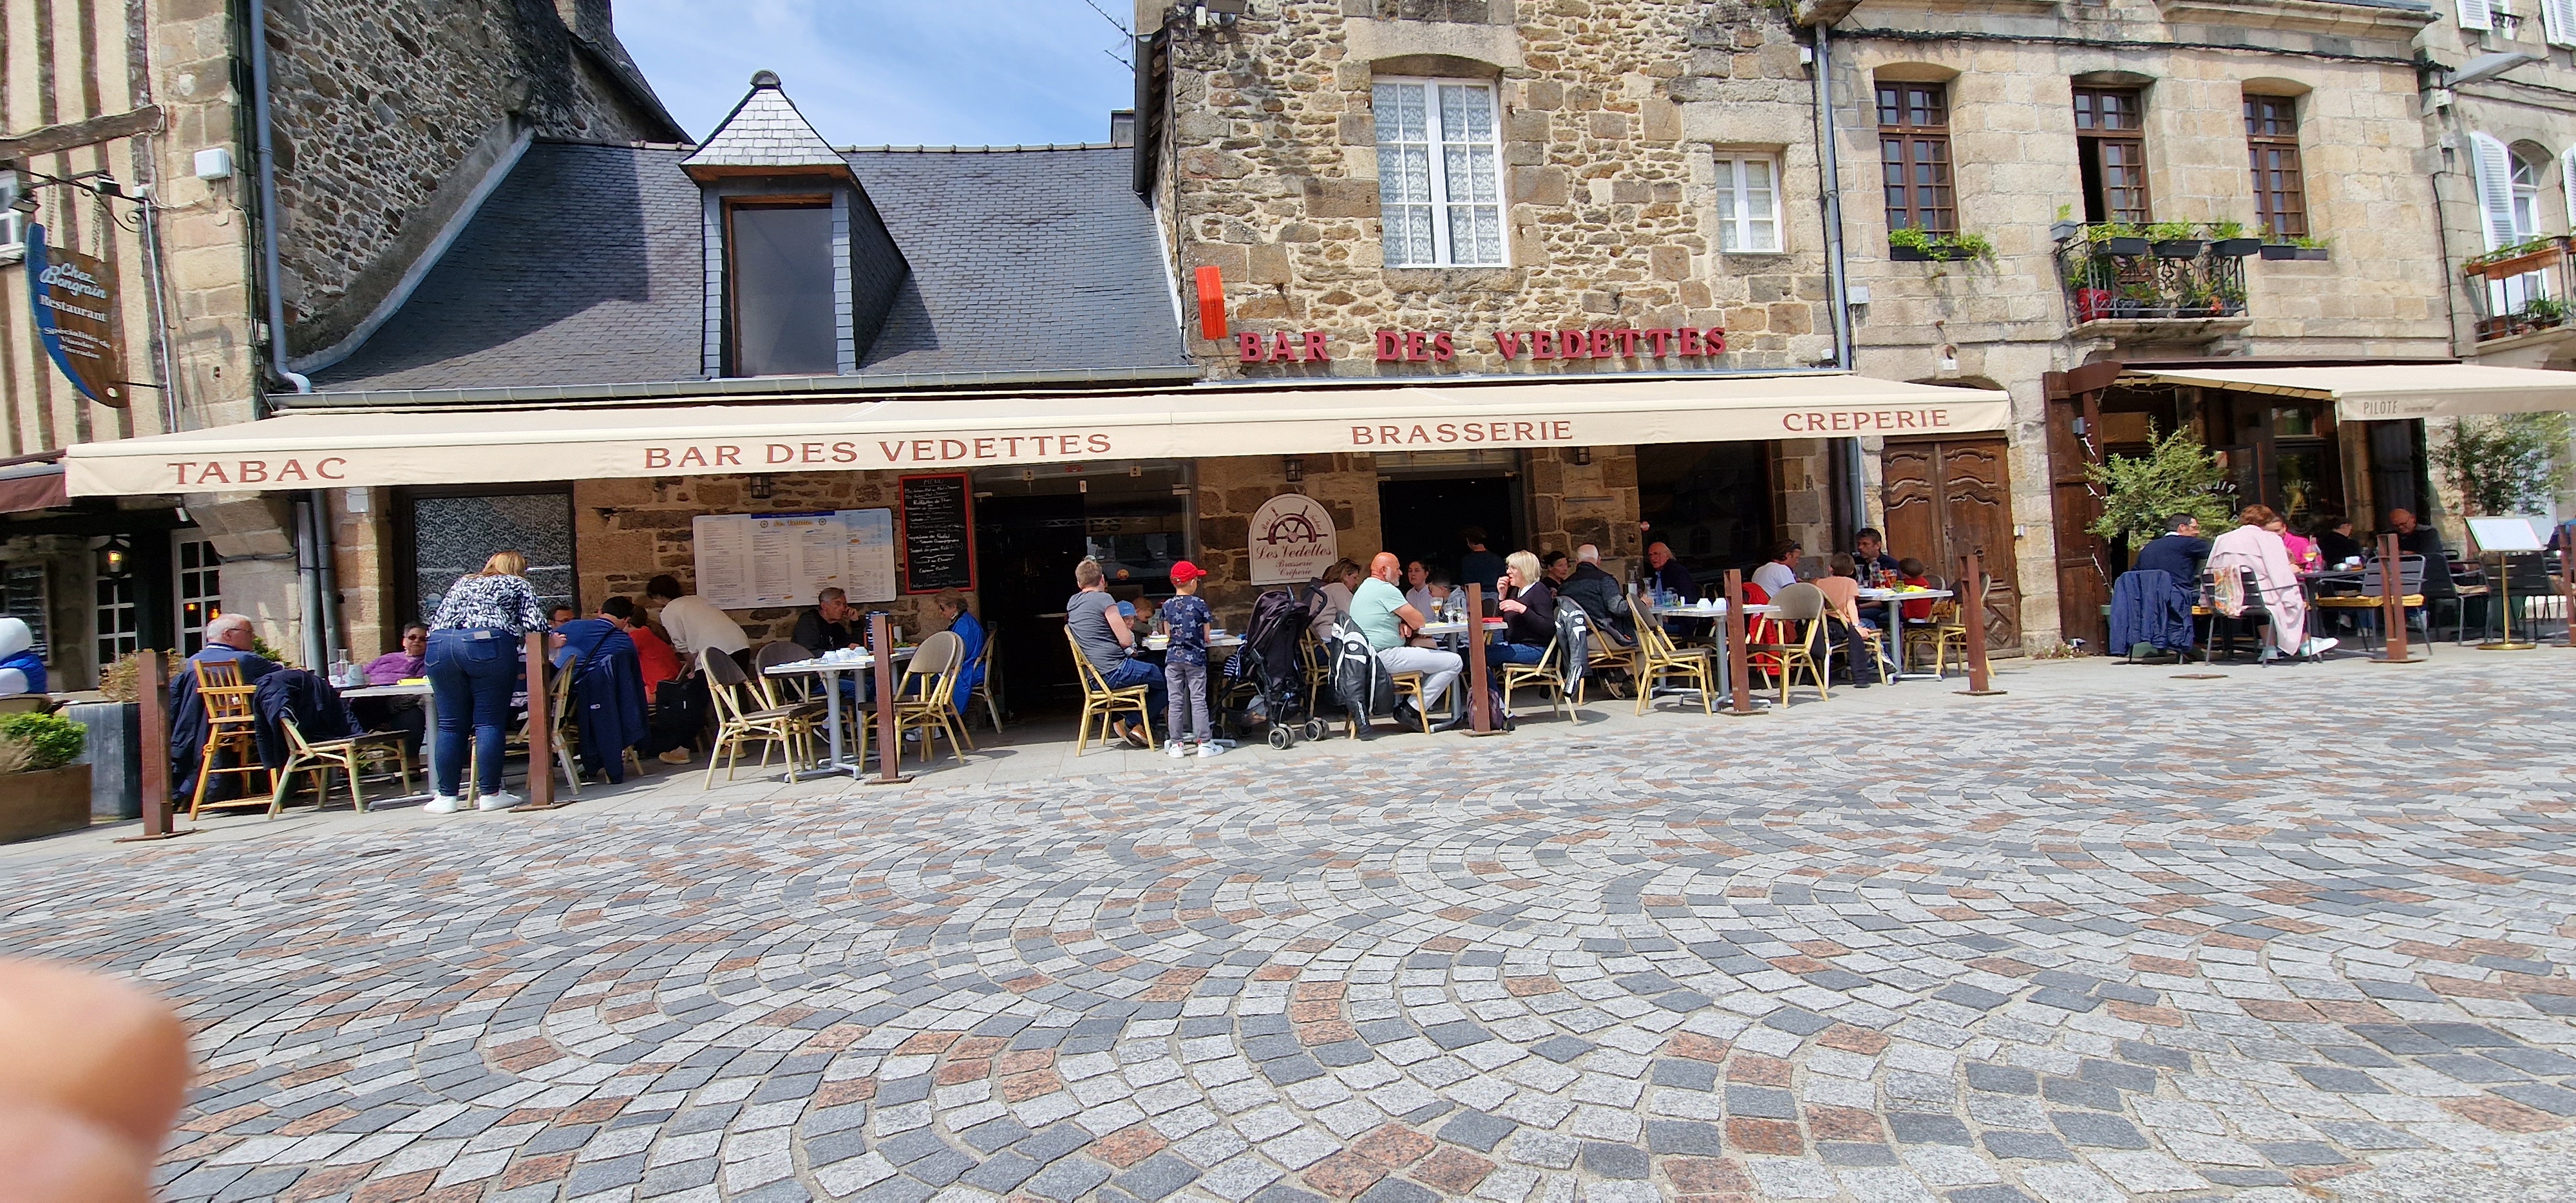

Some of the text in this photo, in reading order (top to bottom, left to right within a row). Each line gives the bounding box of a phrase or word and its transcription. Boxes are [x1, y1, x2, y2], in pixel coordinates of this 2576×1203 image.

[39, 265, 106, 299] Bongrain
[61, 263, 98, 284] Chez
[39, 294, 107, 322] Restaurant
[61, 337, 95, 349] Viandes
[99, 340, 111, 349] de
[1238, 327, 1727, 363] BAR DES VEDETTES
[2363, 401, 2398, 415] PILOTE
[1783, 409, 1951, 432] CREPERIE
[1351, 421, 1574, 445] BRASSERIE
[645, 433, 1112, 469] BAR DES VEDETTES
[167, 457, 347, 485] TABAC
[1261, 518, 1271, 533] Bar
[1255, 543, 1332, 560] Les Vedettes
[1276, 559, 1313, 567] Brasserie
[1278, 567, 1312, 579] Crêperie
